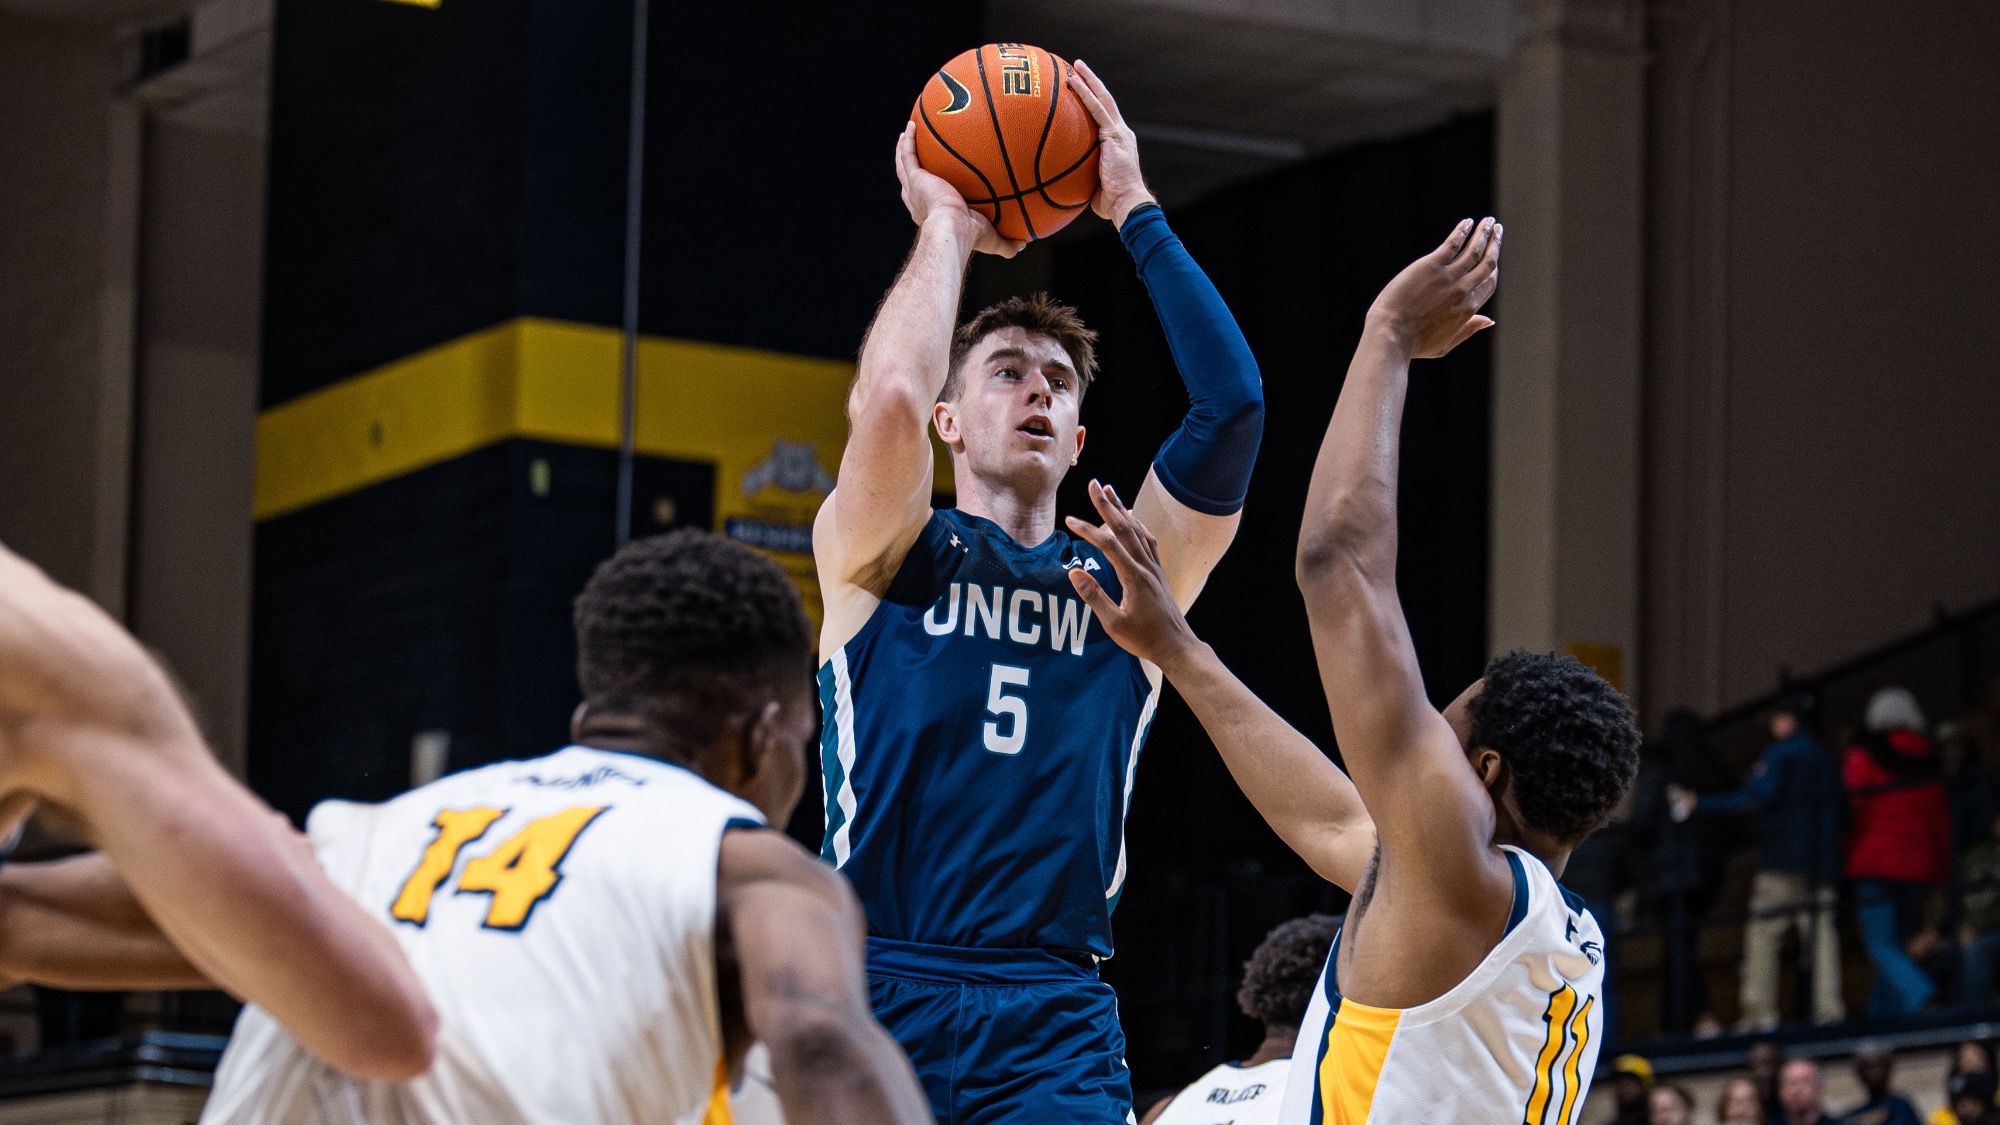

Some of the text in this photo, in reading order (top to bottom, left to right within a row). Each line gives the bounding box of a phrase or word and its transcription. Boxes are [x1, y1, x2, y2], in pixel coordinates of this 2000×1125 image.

[923, 582, 1092, 656] UNCW
[981, 662, 1031, 756] 5
[389, 805, 613, 932] 14
[1524, 980, 1595, 1125] 11
